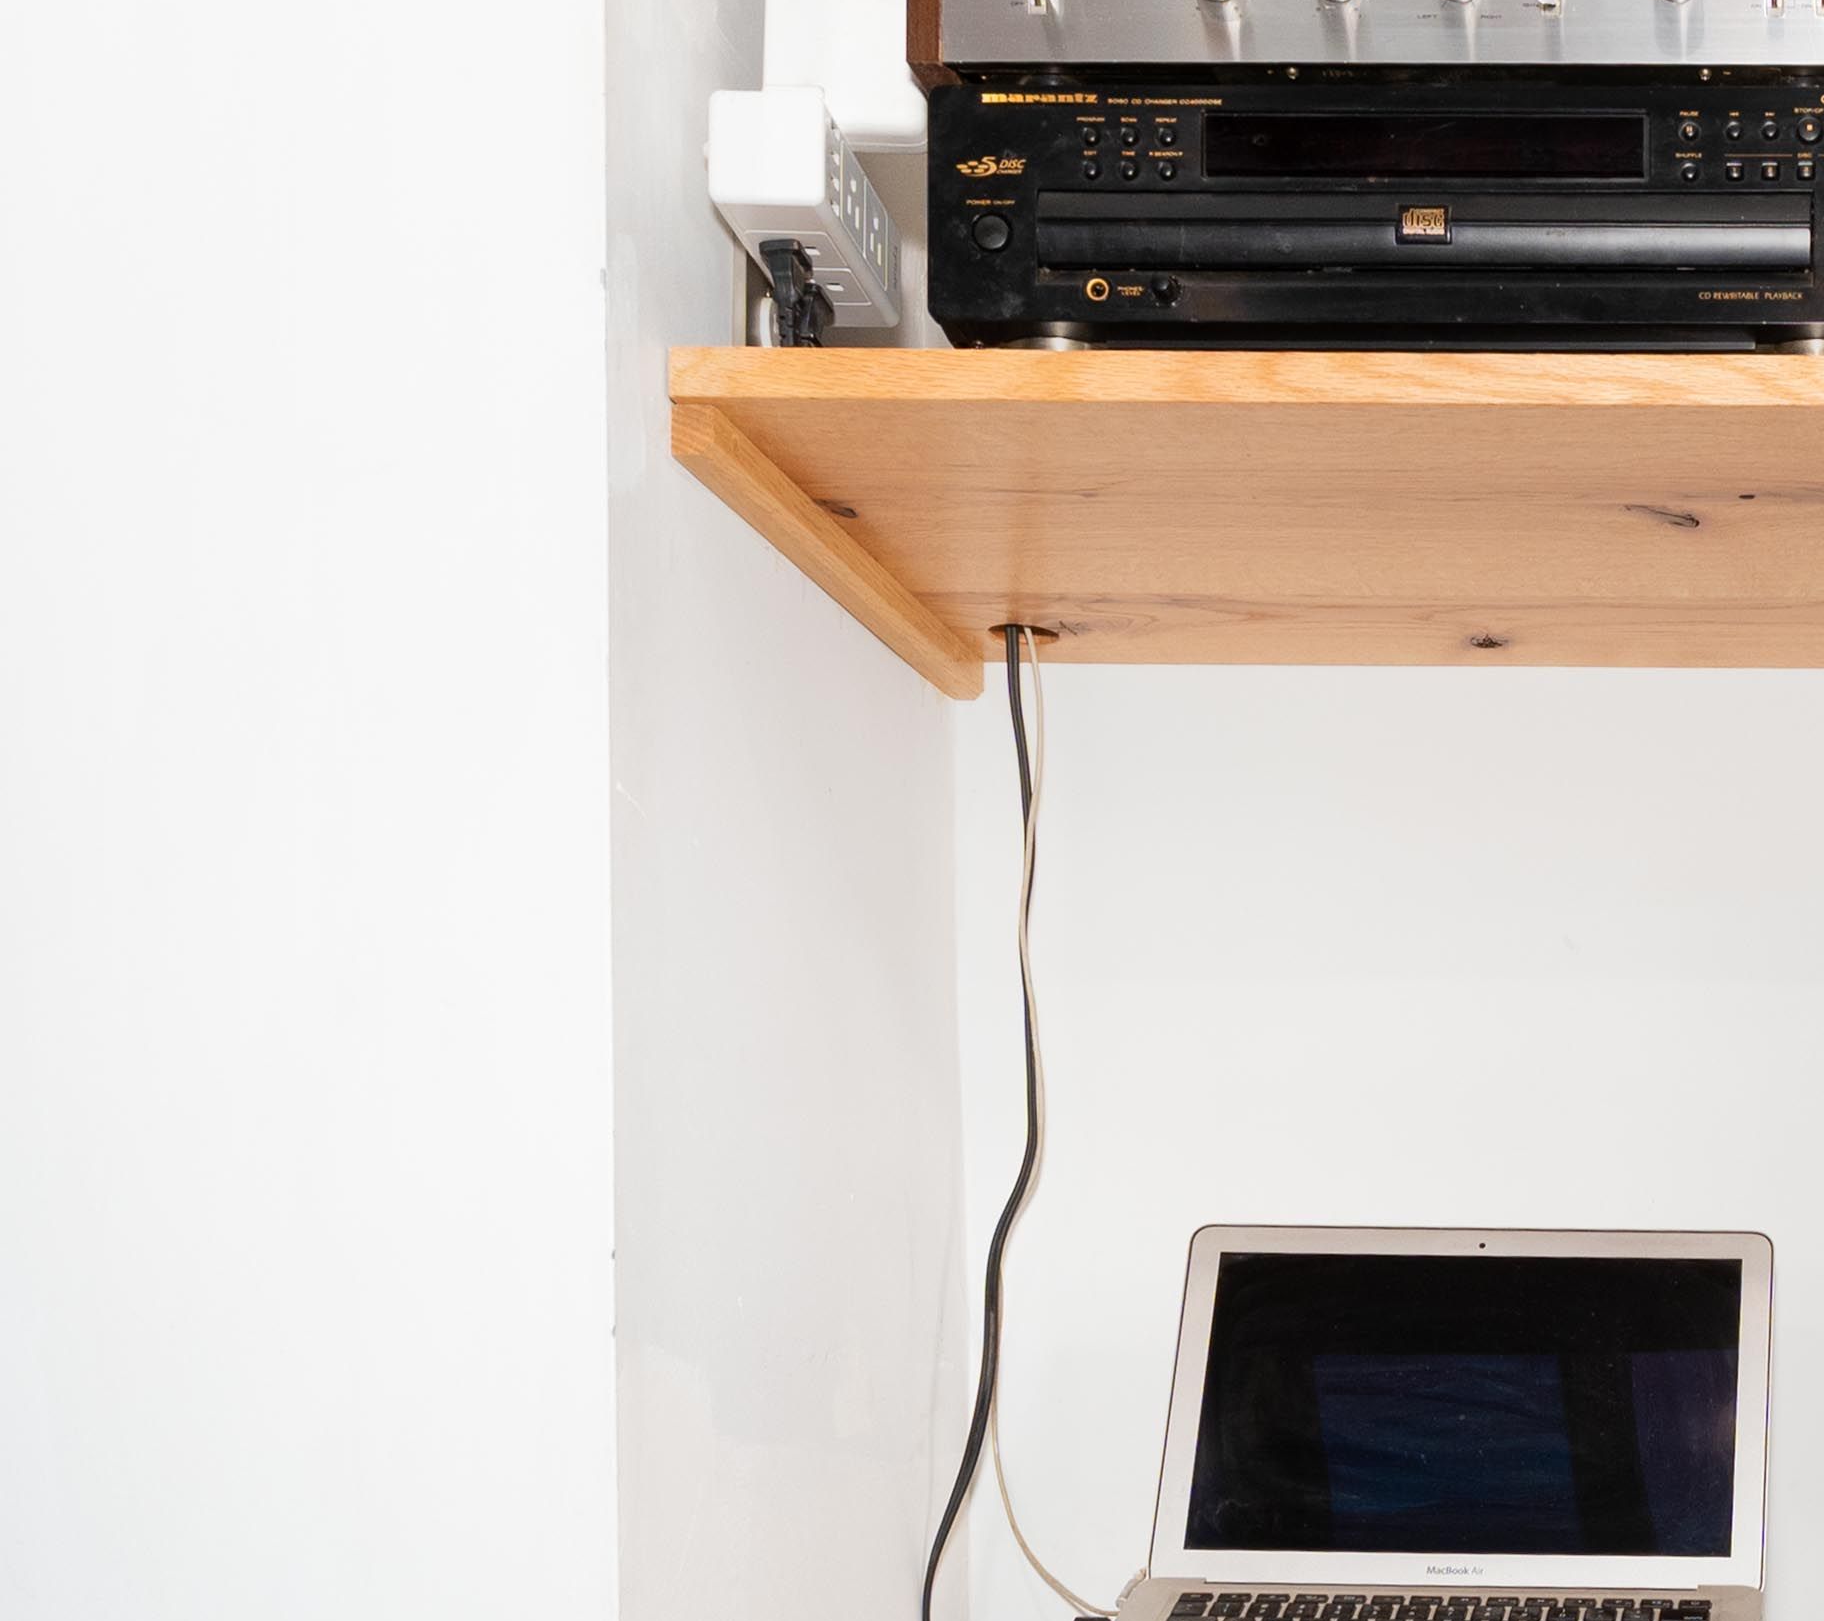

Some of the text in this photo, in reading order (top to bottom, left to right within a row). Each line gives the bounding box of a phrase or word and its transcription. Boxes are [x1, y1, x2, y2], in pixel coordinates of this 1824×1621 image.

[981, 92, 1098, 104] marantz
[999, 158, 1027, 169] DISC
[1698, 291, 1803, 300] CD REWRITABLE PLAYBACK
[1426, 1565, 1484, 1576] MacBook Air
